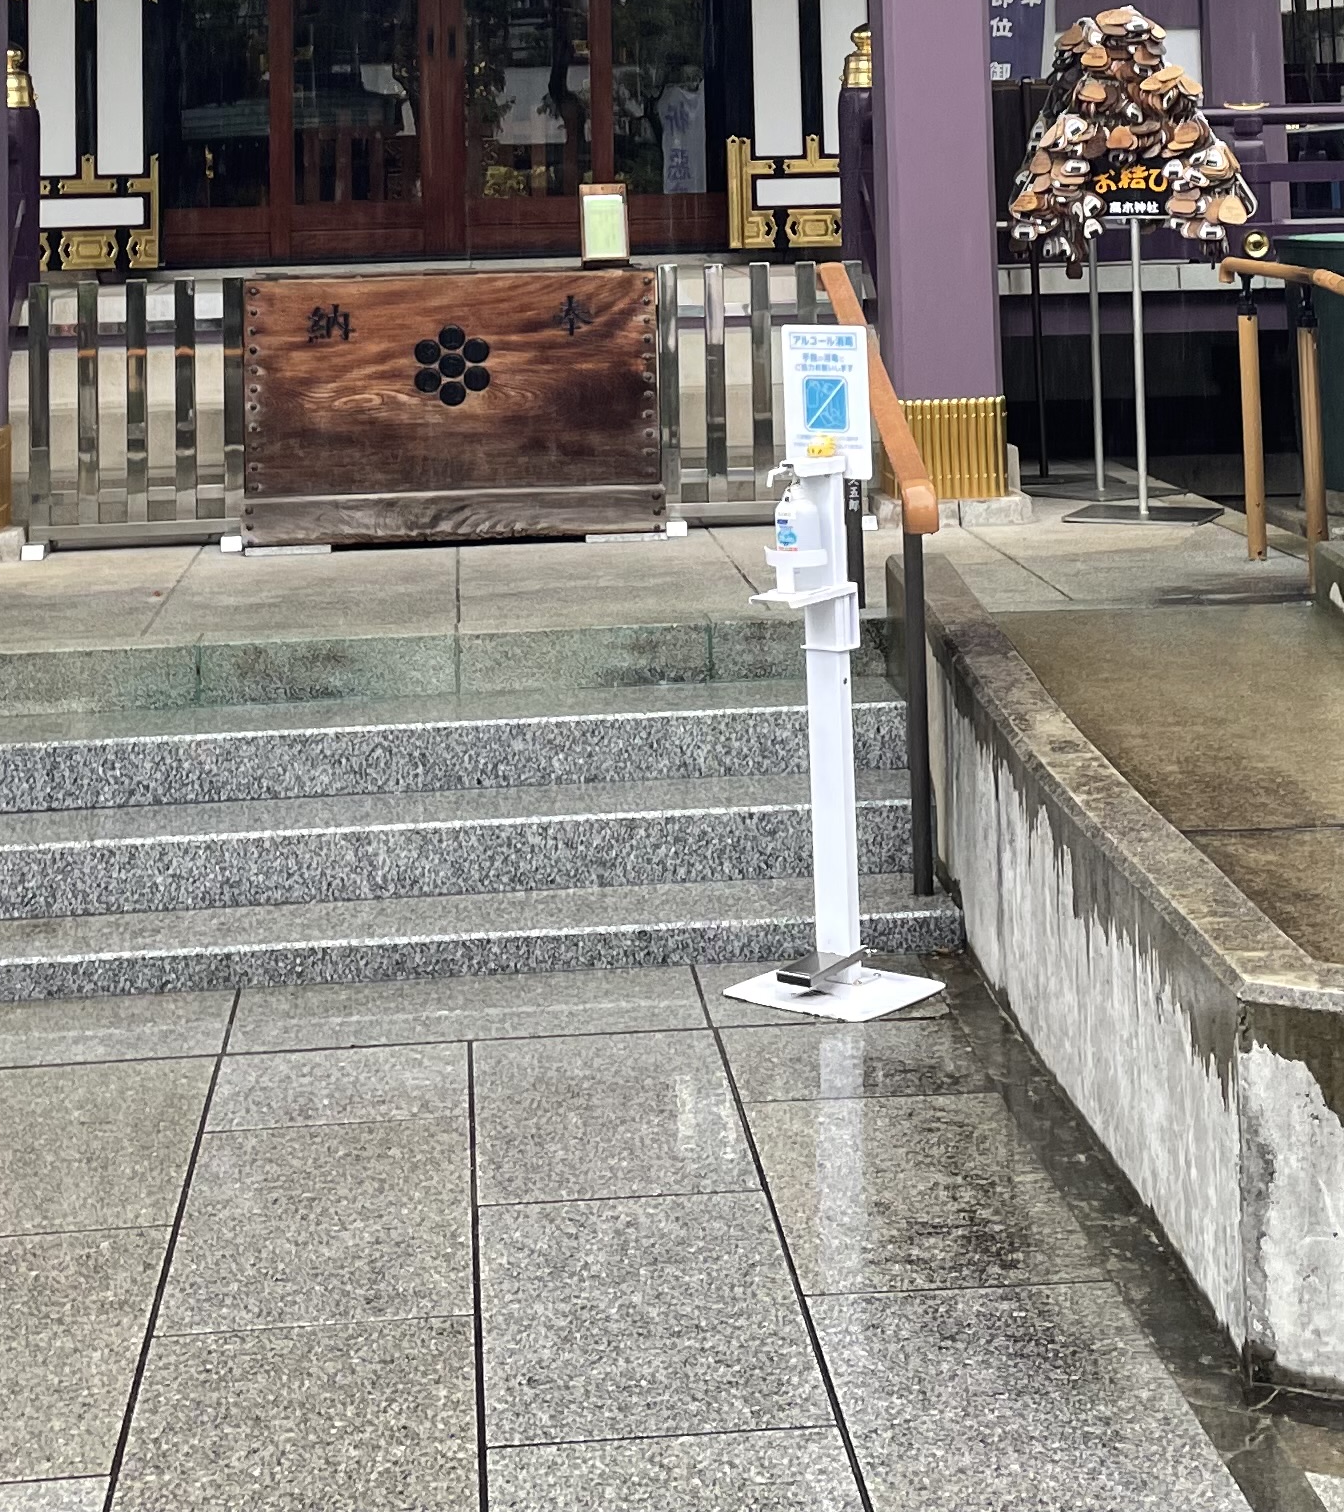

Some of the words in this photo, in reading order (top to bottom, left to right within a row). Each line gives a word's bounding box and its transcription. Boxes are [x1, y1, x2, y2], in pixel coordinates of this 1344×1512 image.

[1109, 201, 1160, 214] 高木神社
[307, 303, 355, 343] 納
